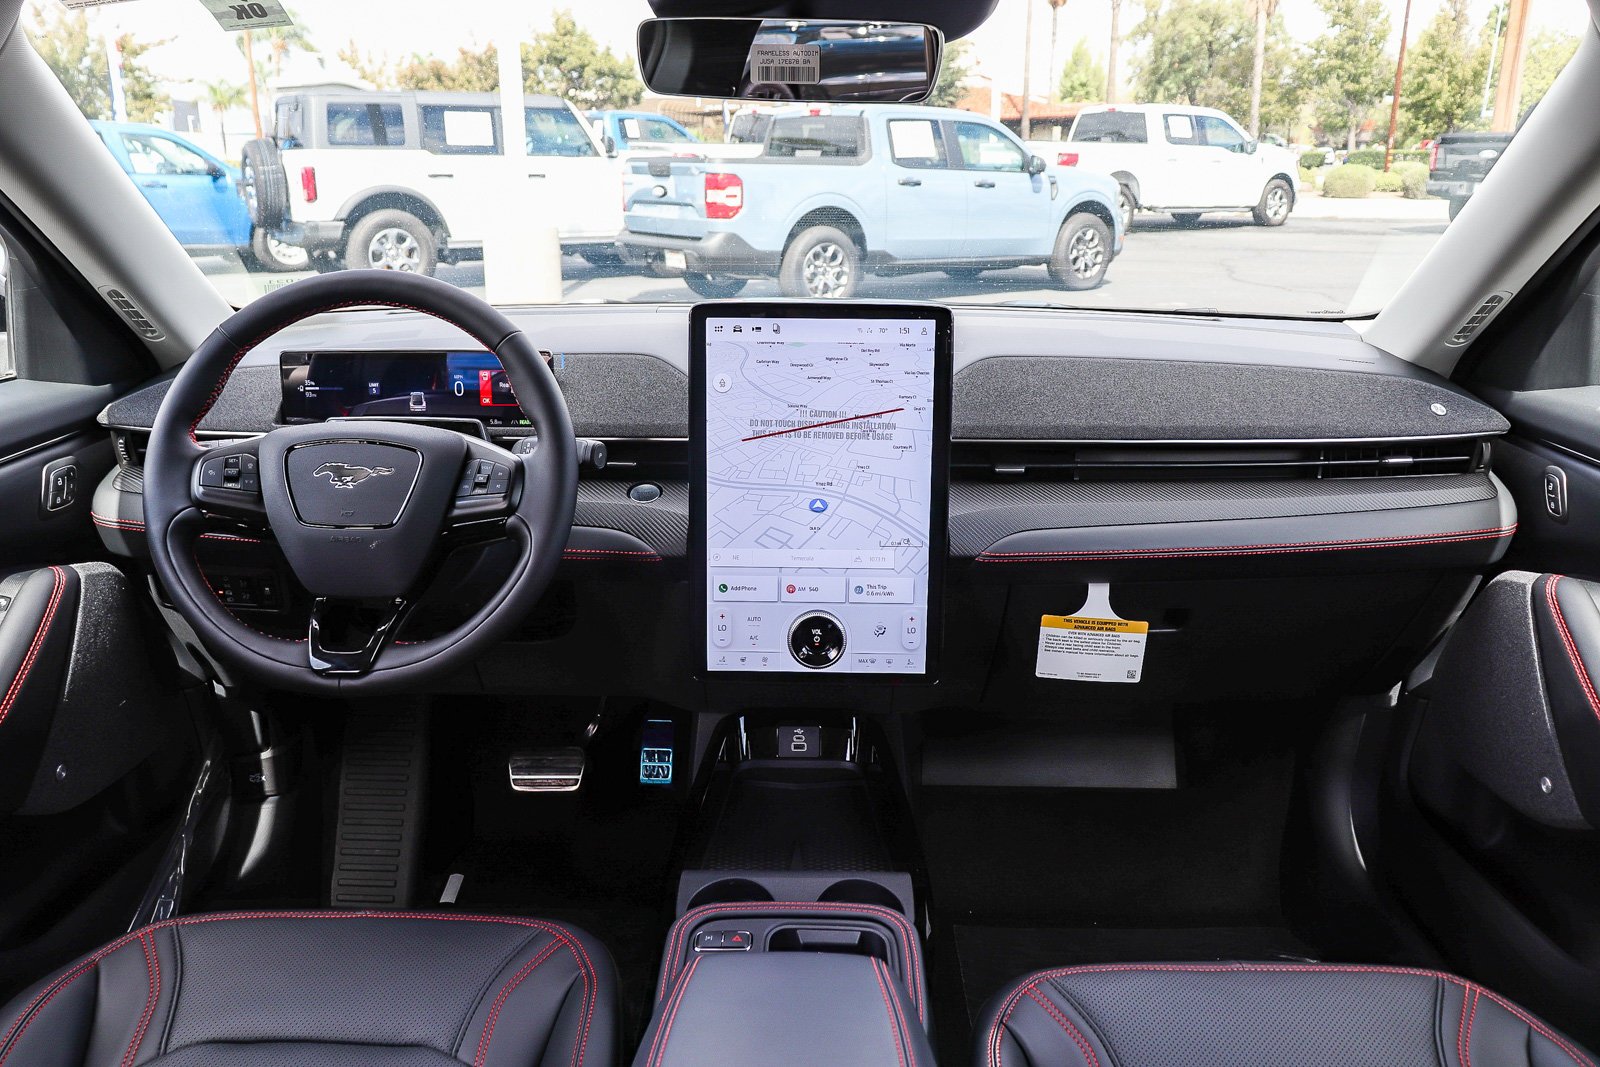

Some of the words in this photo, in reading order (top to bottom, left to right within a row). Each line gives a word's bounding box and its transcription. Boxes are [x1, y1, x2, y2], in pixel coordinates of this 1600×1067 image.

[228, 3, 268, 20] OK
[454, 381, 464, 396] 0
[810, 410, 838, 418] CAUTION
[750, 419, 759, 427] DO
[760, 419, 773, 428] NOT
[774, 419, 796, 428] TOUCH
[798, 420, 824, 429] DISPLAY
[852, 421, 897, 430] INSTALLATION
[794, 431, 802, 439] TO
[804, 431, 812, 439] BE
[814, 431, 844, 440] REMOVED
[846, 432, 870, 441] BEFORE
[872, 433, 893, 441] USAGE
[730, 583, 740, 591] Add
[741, 583, 757, 591] Phone
[718, 624, 727, 632] LO
[907, 627, 916, 635] LO
